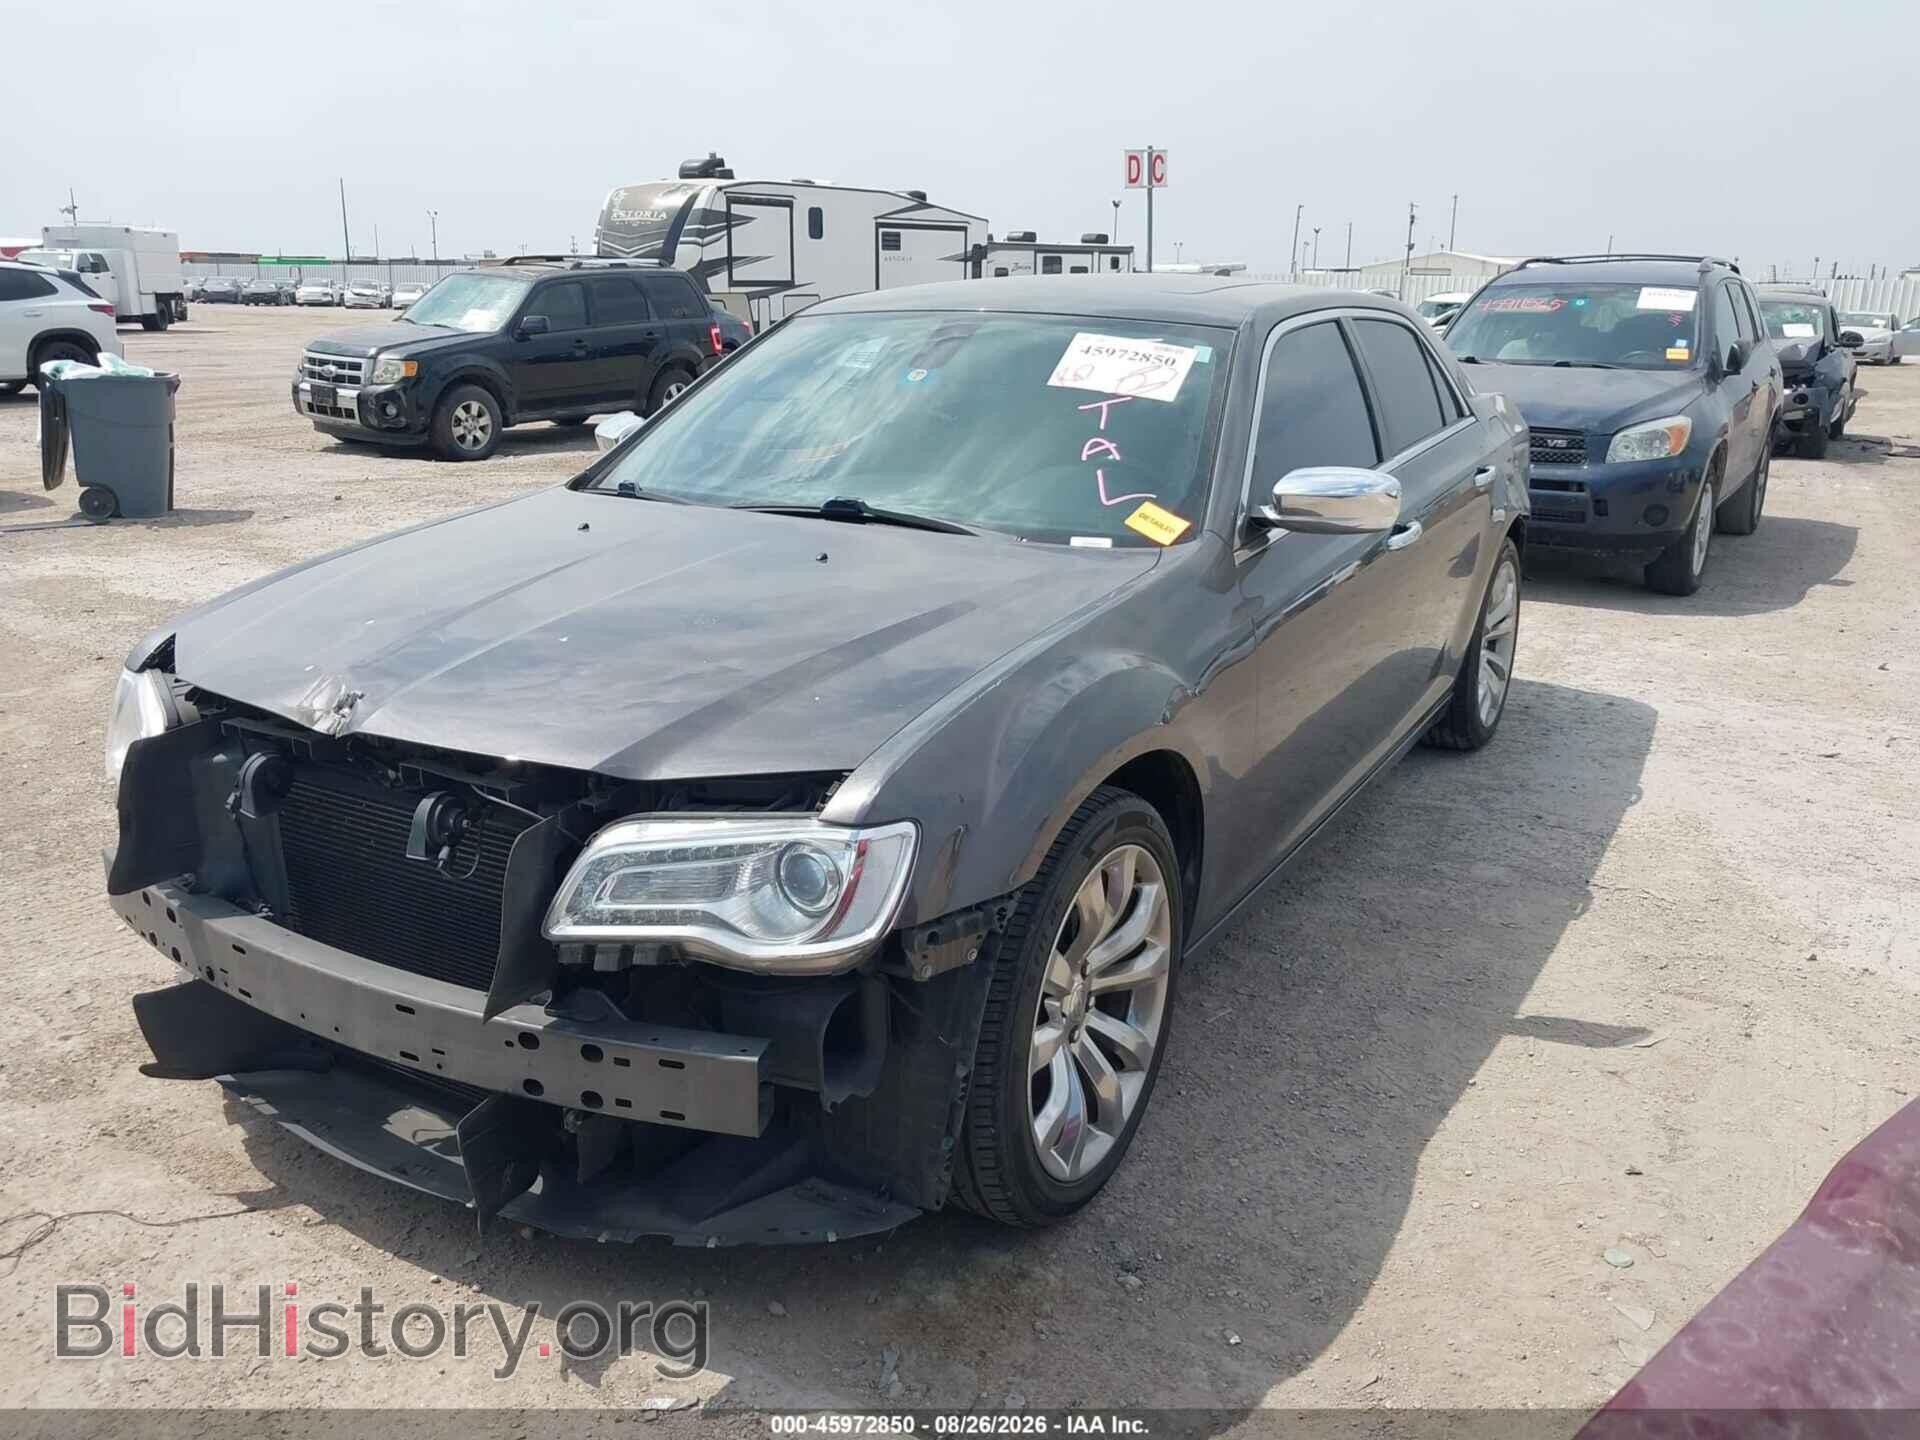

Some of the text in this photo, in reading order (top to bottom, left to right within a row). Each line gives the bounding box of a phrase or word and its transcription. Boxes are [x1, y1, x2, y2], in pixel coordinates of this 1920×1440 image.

[1128, 155, 1140, 184] D
[1152, 154, 1164, 183] C
[1080, 344, 1176, 368] 45972850
